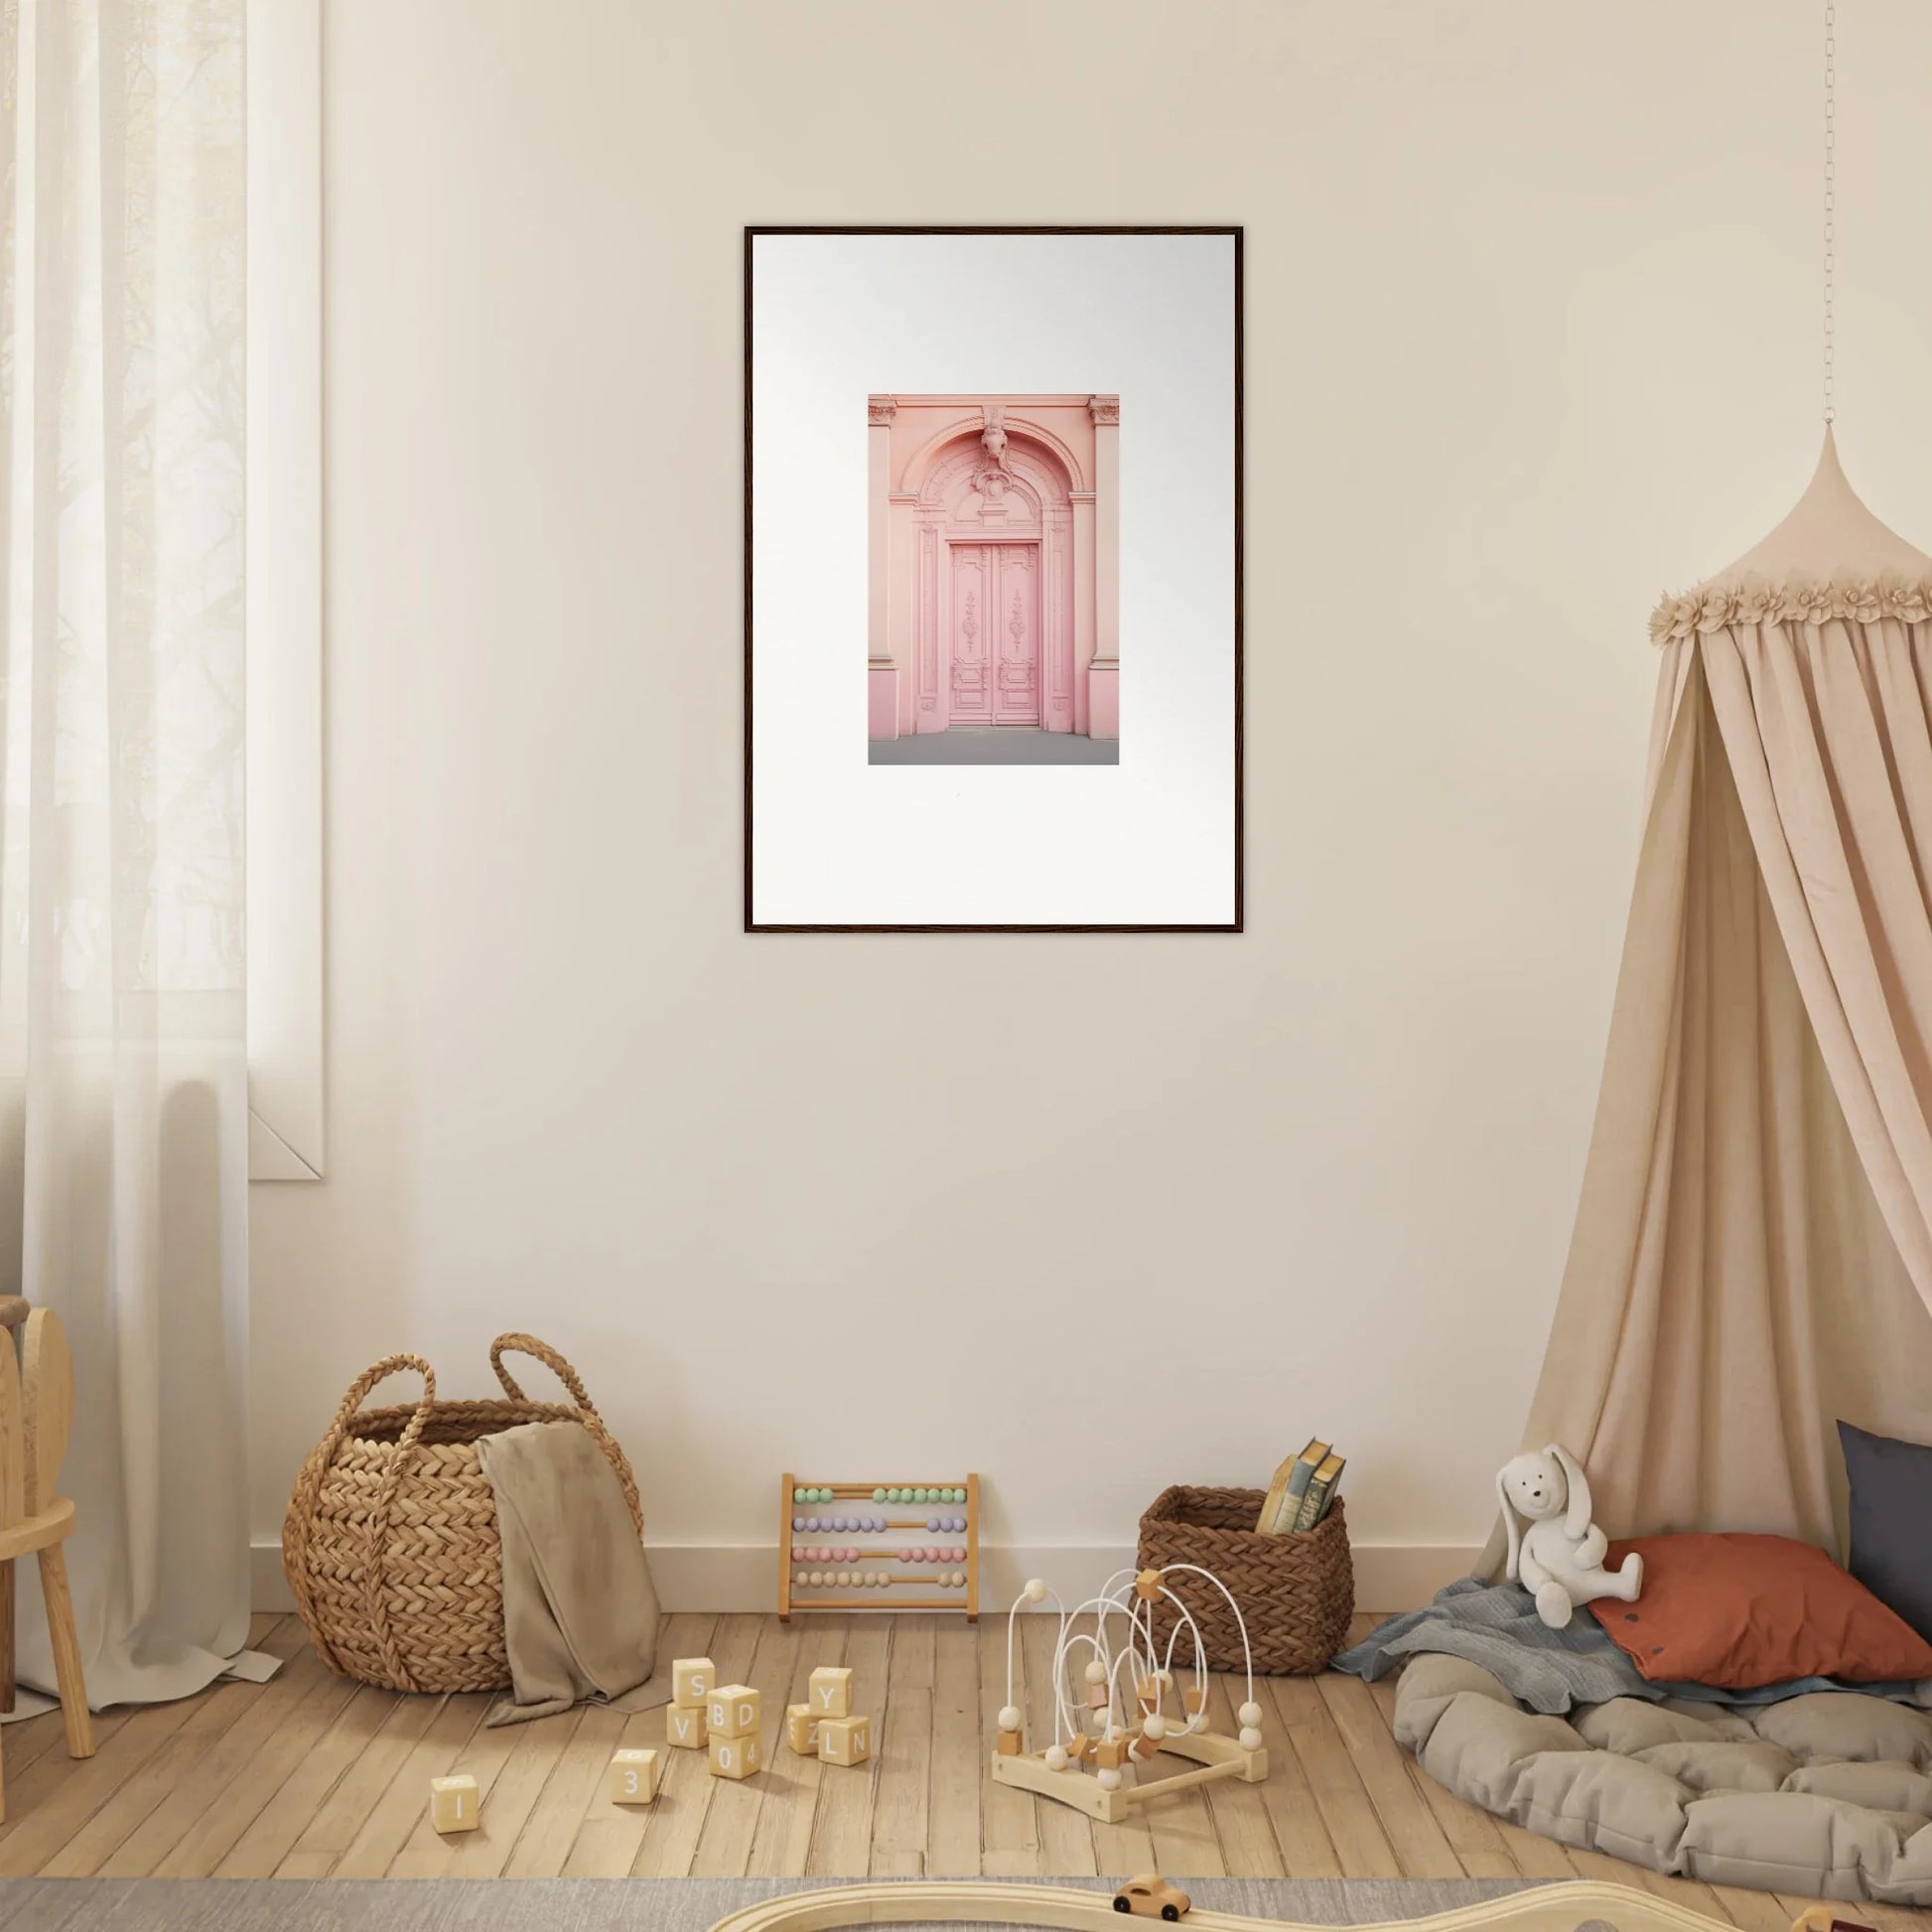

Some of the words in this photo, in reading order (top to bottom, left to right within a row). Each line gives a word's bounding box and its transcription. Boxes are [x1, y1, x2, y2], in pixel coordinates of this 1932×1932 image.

[691, 1675, 706, 1697] S
[818, 1687, 835, 1710] Y
[713, 1704, 725, 1726] B
[739, 1704, 754, 1726] D
[675, 1718, 690, 1740] V
[825, 1731, 839, 1755] L
[854, 1728, 866, 1753] N
[624, 1770, 638, 1794] 3
